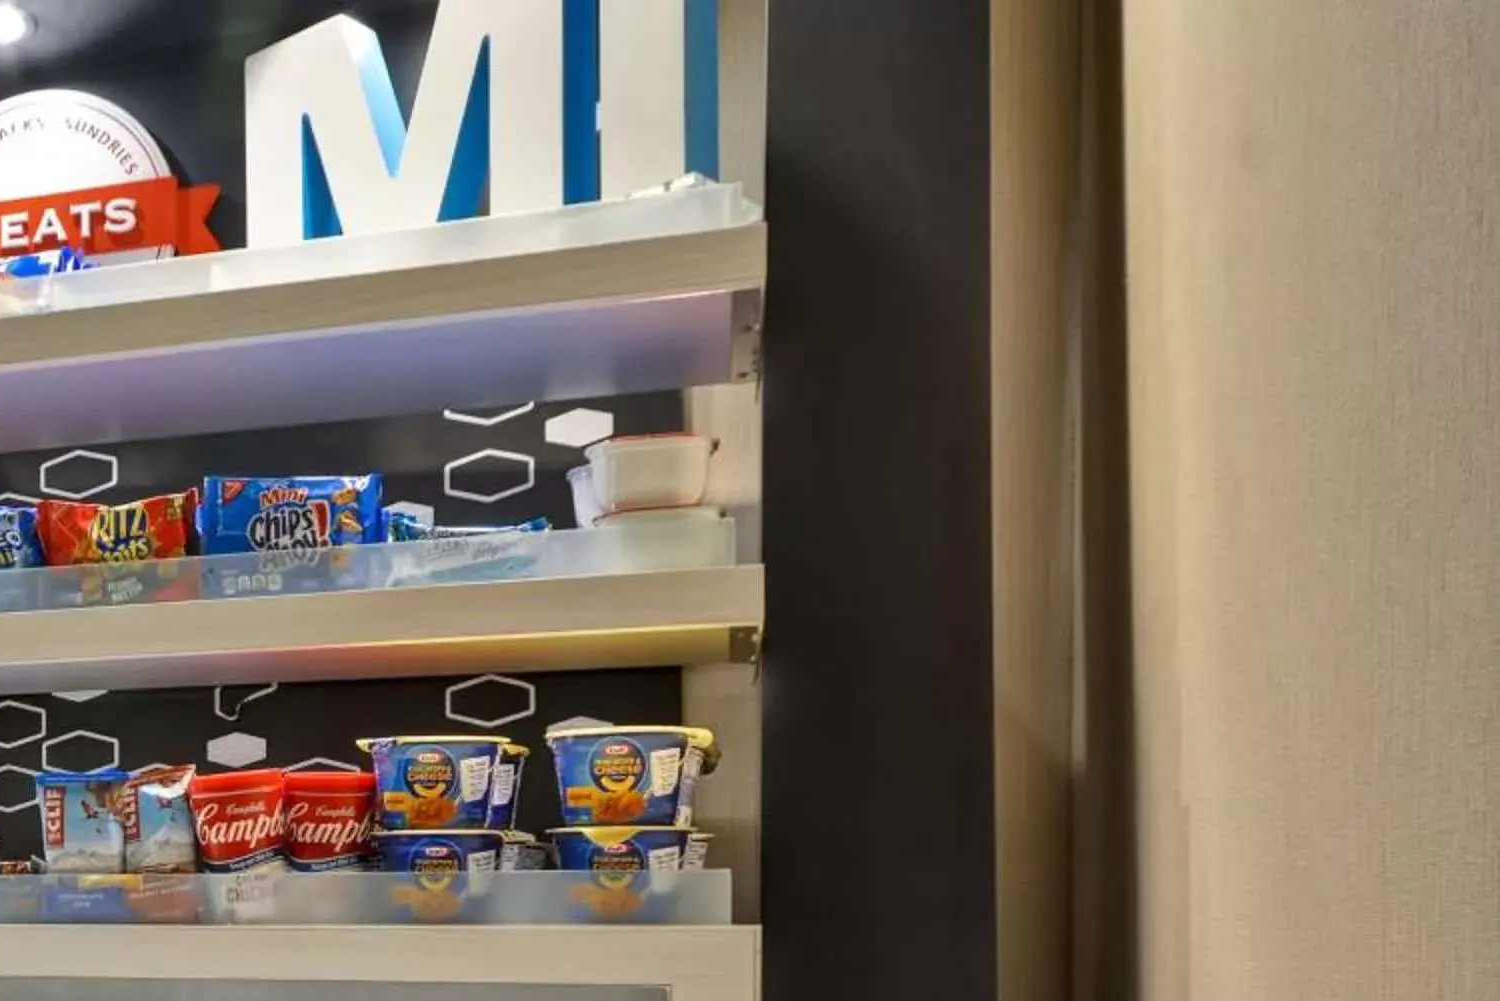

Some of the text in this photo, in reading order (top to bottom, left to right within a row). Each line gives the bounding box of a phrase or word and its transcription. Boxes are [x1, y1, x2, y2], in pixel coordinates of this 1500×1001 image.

[64, 115, 140, 176] SUNDRIES
[260, 488, 308, 505] Mini
[92, 505, 146, 548] RITZ
[248, 508, 313, 549] Chips
